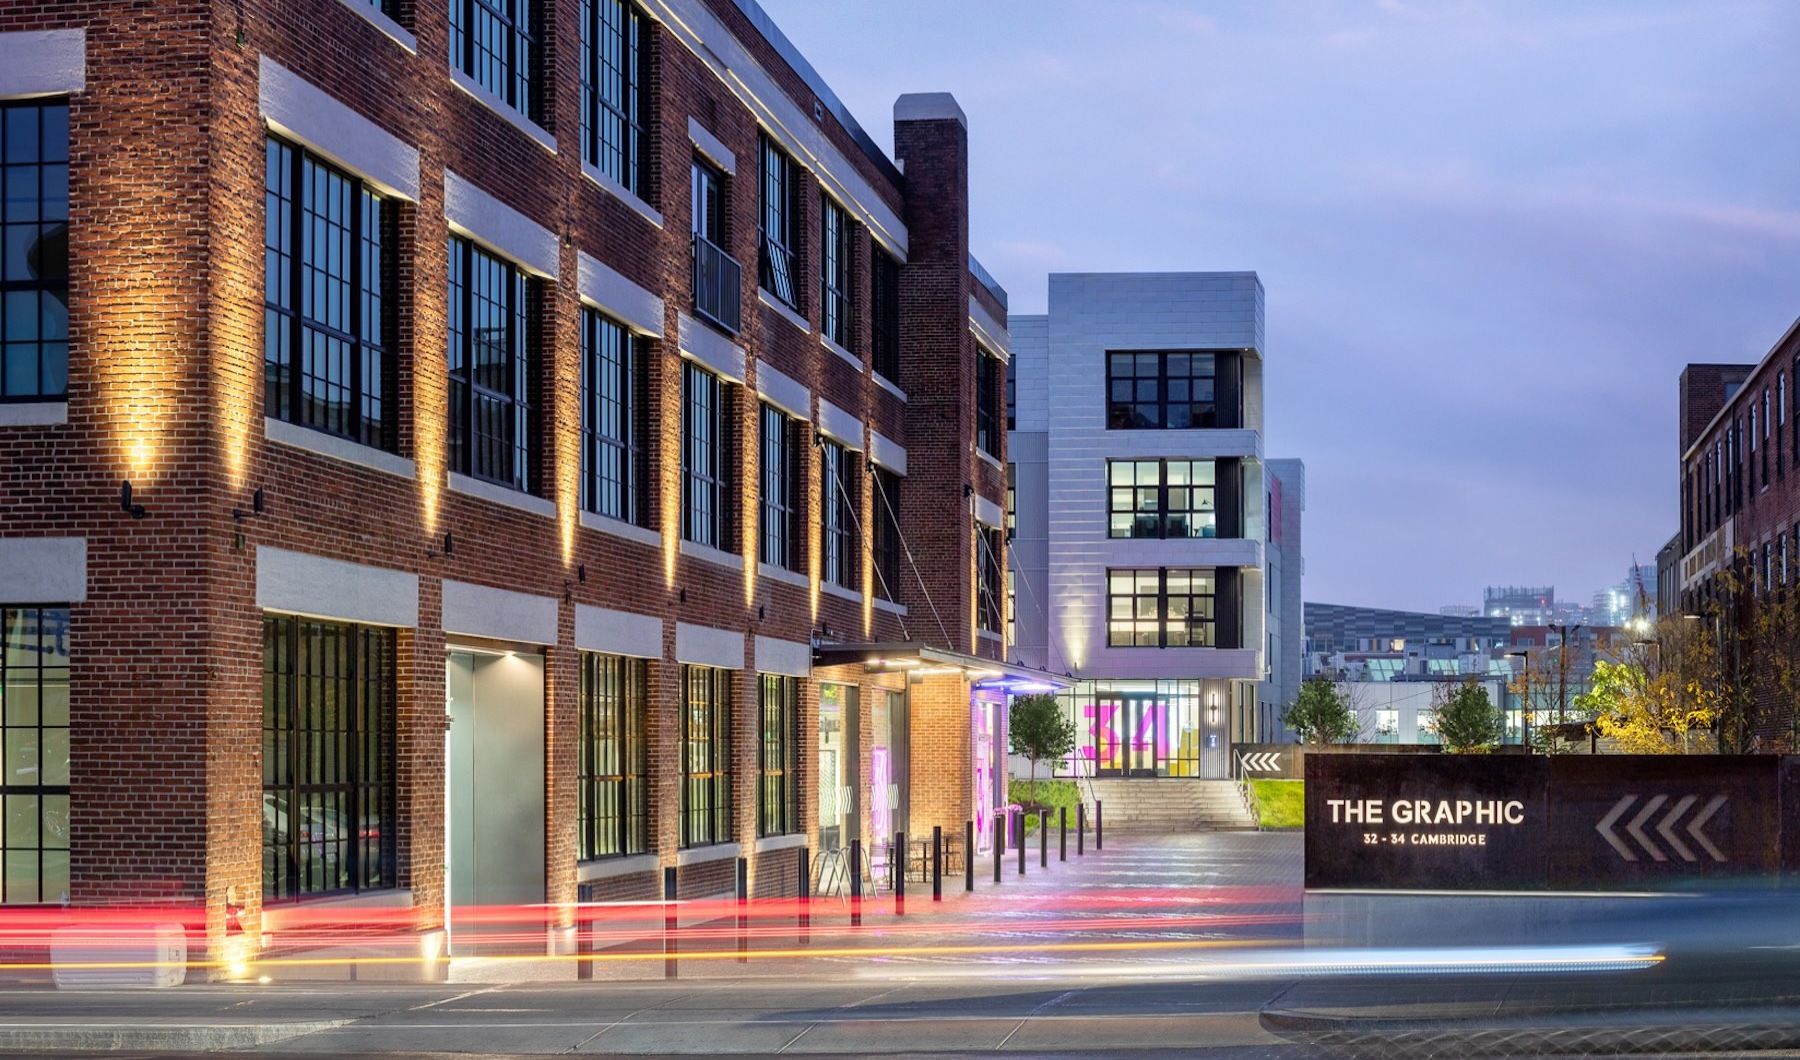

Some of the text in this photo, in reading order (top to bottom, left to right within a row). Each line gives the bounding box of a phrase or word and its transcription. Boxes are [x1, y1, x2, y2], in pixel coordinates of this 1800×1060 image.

[1081, 705, 1170, 763] 34
[1326, 799, 1525, 825] THE GRAPHIC
[1363, 832, 1379, 846] 32
[1390, 832, 1406, 846] 34
[1410, 832, 1486, 846] CAMBRIDGE
